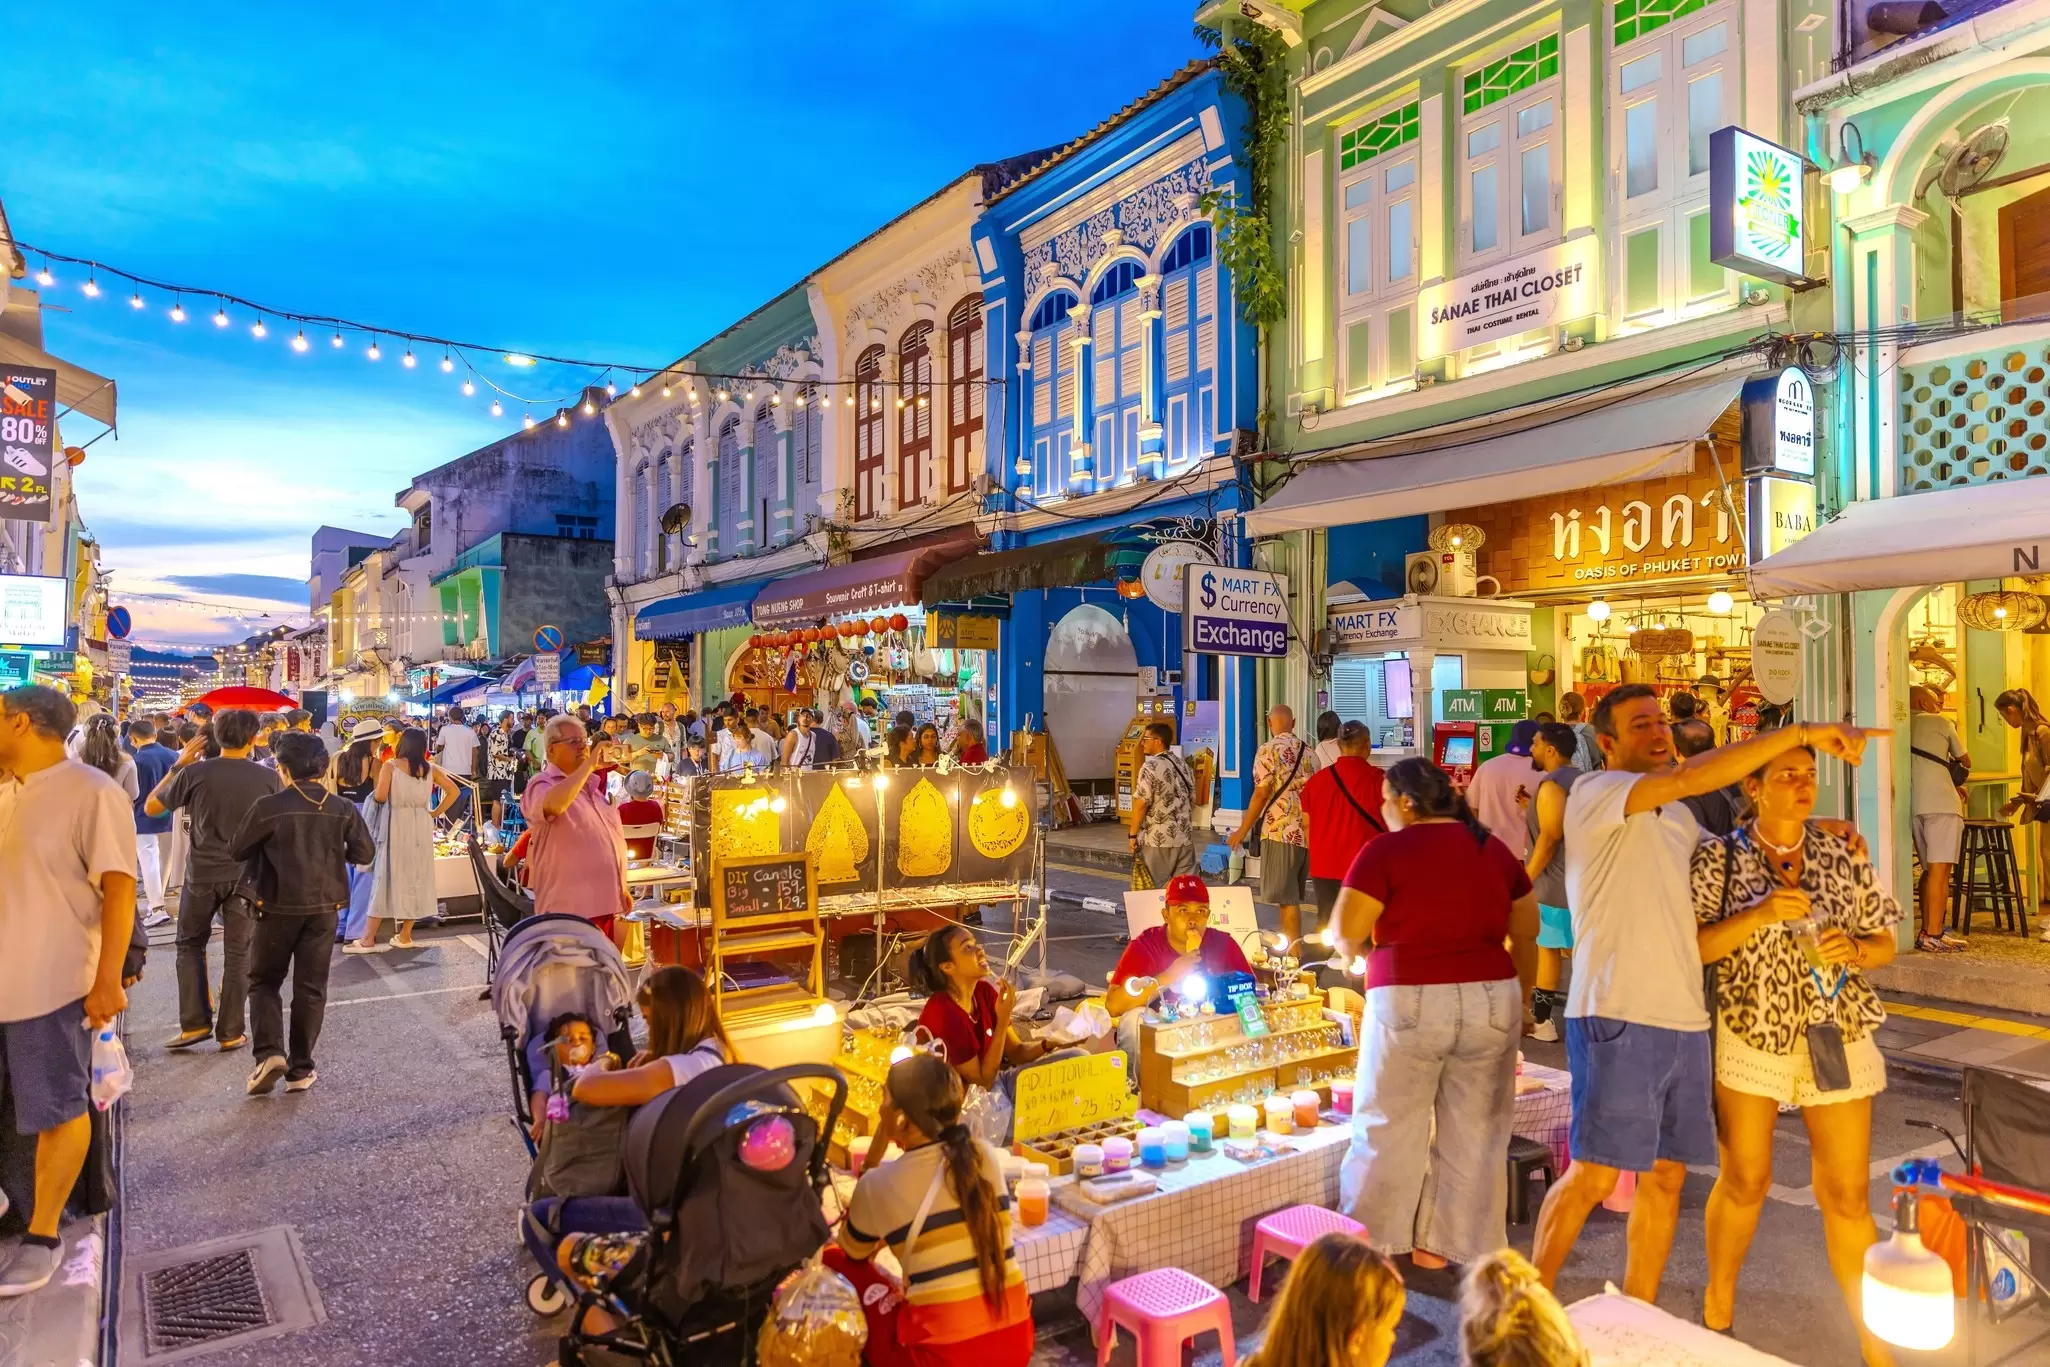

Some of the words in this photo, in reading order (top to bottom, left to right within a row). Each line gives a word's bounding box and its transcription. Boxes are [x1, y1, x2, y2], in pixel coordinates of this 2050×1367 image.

[1431, 298, 1480, 325] SANAE
[1484, 287, 1517, 309] THAI
[1521, 264, 1583, 297] CLOSET
[1467, 325, 1480, 334] THAI
[1483, 316, 1513, 329] COSTUME
[1516, 309, 1539, 320] RENTAL
[11, 375, 47, 386] OUTLET
[3, 396, 48, 419] SALE
[21, 476, 34, 493] 2
[36, 486, 47, 494] FL
[1775, 511, 1812, 532] BABA
[1574, 565, 1616, 580] OASIS
[1620, 563, 1638, 575] OF
[1643, 556, 1701, 574] PHUKET
[2013, 545, 2039, 572] N
[825, 590, 850, 605] Souvenir
[873, 580, 896, 595] T-shirt
[1222, 577, 1259, 595] MART
[1263, 582, 1280, 597] FX
[756, 604, 770, 616] TONG
[771, 601, 788, 614] NUENG
[789, 598, 804, 611] SHOP
[1221, 595, 1281, 619] Currency
[1335, 613, 1373, 631] MART
[1378, 611, 1397, 627] FX
[1197, 620, 1285, 652] Exchange
[1366, 629, 1398, 639] Exchange
[1773, 641, 1783, 649] THAI
[1449, 698, 1475, 712] ATM
[1493, 698, 1517, 712] ATM
[727, 871, 749, 885] DIY
[753, 864, 802, 882] Candle
[727, 885, 749, 900] Big
[729, 898, 760, 913] Small
[1228, 985, 1239, 993] TIP
[1239, 982, 1253, 991] BOX
